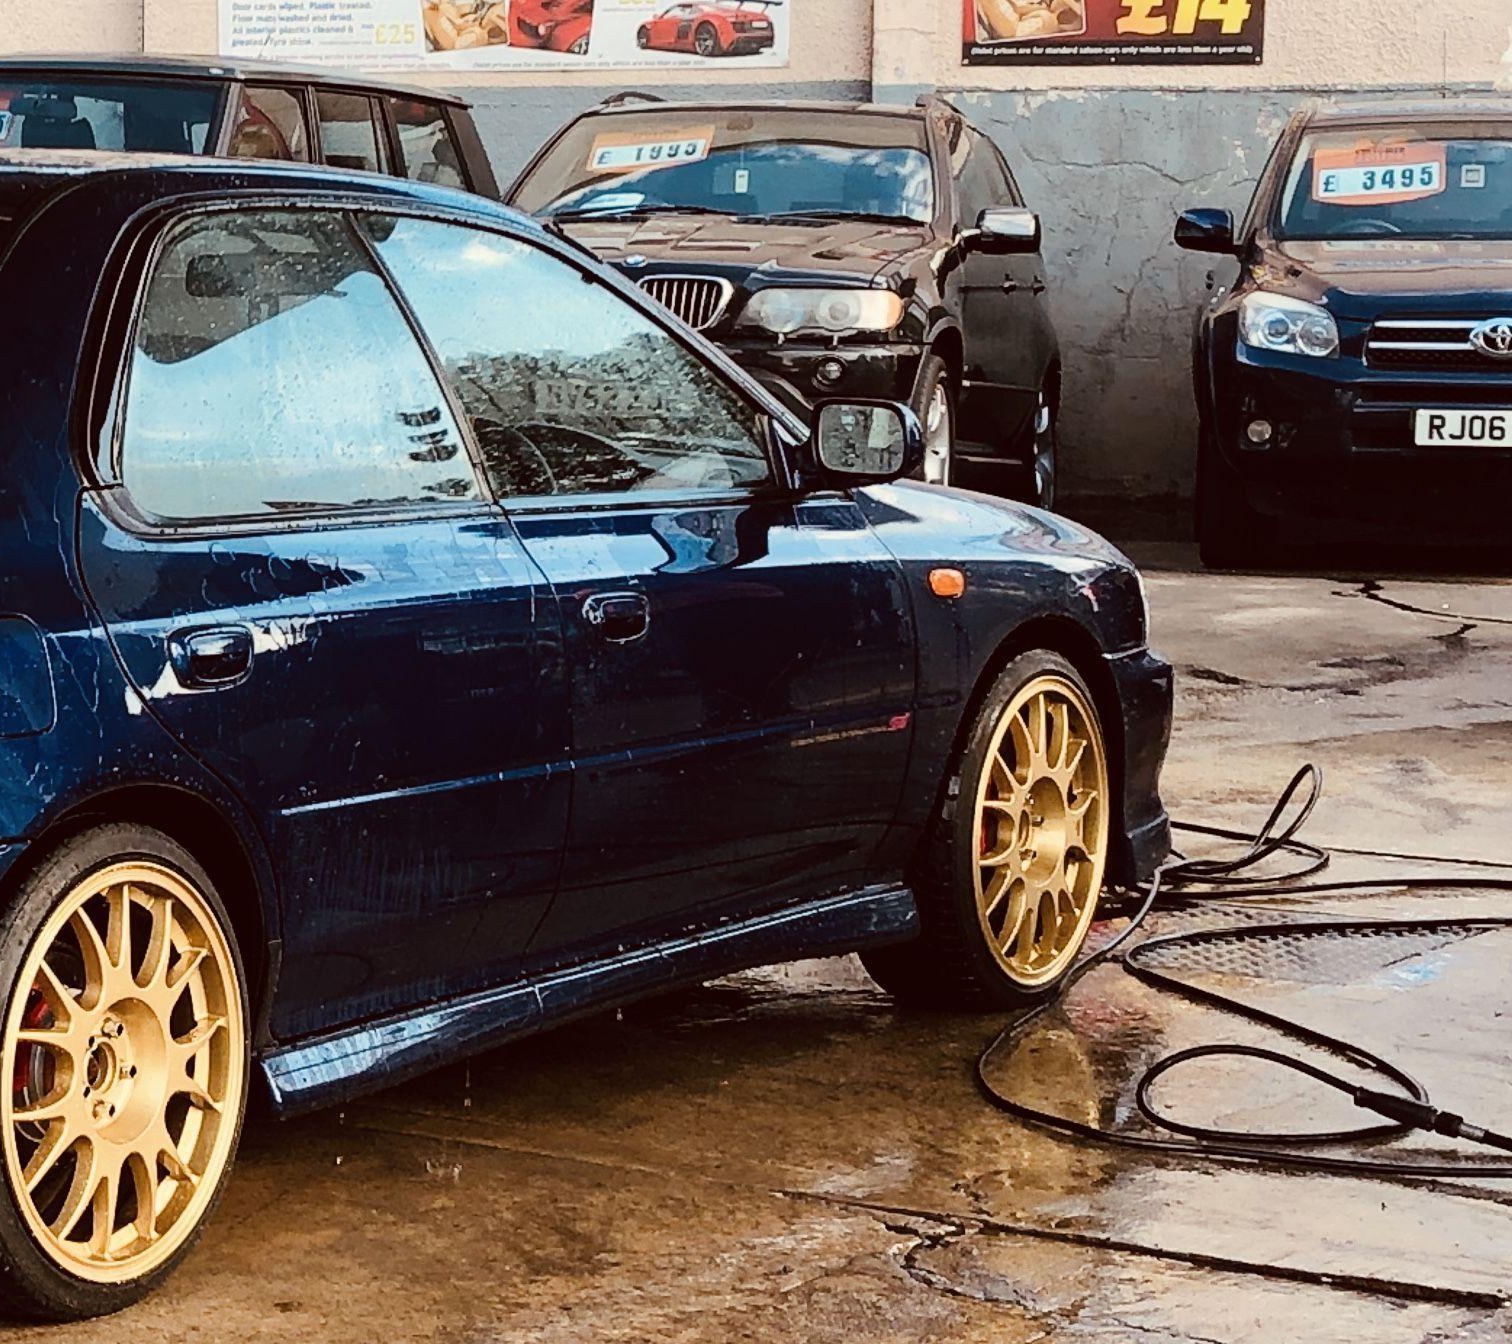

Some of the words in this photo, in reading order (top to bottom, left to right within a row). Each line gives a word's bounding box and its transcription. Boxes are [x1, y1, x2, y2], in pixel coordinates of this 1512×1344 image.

[376, 23, 415, 44] £25
[1323, 175, 1336, 193] £
[1362, 166, 1433, 191] 3495
[1429, 414, 1506, 441] RJ06
